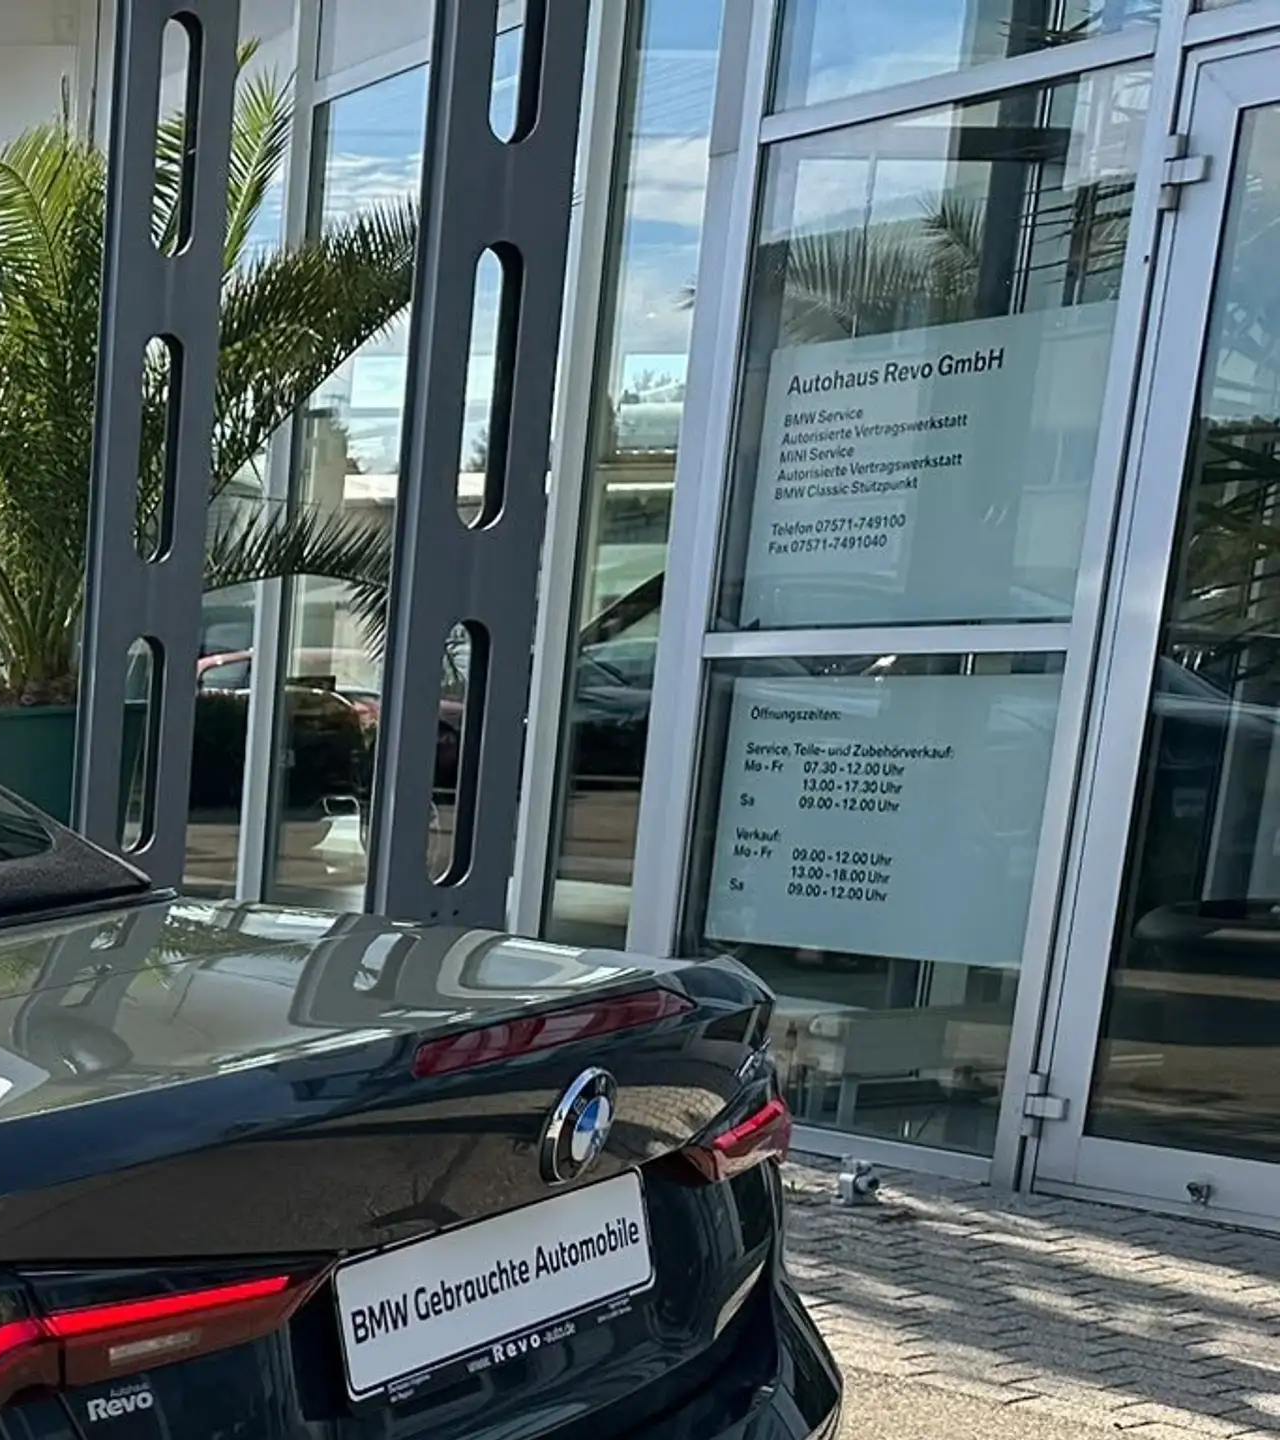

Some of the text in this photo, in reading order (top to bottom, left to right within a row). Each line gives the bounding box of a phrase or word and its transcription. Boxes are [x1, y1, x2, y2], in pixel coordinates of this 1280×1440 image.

[787, 348, 1005, 396] Autohaus Revo GmbH
[784, 408, 864, 428] BMW Service
[781, 414, 968, 446] Autorisierte Vertragswerkstatt
[779, 446, 855, 464] MINI Service
[777, 453, 963, 483] Autorisierte Vertragswerkstatt
[775, 484, 805, 500] BMW
[807, 481, 850, 497] Classic
[771, 513, 906, 537] Telefon 07571-749100
[768, 534, 888, 555] Fax 07571-7491040
[828, 745, 850, 757] und
[744, 760, 762, 772] Mo
[771, 760, 784, 772] Fr
[803, 761, 837, 775] 07.30
[847, 762, 880, 776] 12.00
[882, 763, 905, 777] Uhr
[803, 779, 835, 792] 13.00
[844, 780, 877, 794] 17.30
[880, 781, 902, 795] Uhr
[740, 794, 755, 807] Sa
[799, 796, 833, 810] 09.00
[842, 798, 875, 812] 12.00
[877, 799, 900, 813] Uhr
[736, 827, 782, 842] Verkauf:
[733, 844, 752, 858] Mo
[761, 846, 773, 858] Fr
[793, 848, 826, 862] 09.00
[835, 850, 868, 864] 12.00
[870, 852, 892, 865] Uhr
[791, 866, 824, 879] 13.00
[868, 870, 891, 884] Uhr
[729, 878, 744, 891] Sa
[787, 883, 821, 897] 09.00
[831, 886, 863, 900] 12.00
[865, 887, 888, 902] Uhr
[351, 1294, 408, 1344] BMW
[414, 1259, 530, 1321] Gebrauchte
[535, 1217, 640, 1279] Automobile
[492, 1332, 541, 1364] Revo
[86, 1391, 154, 1422] Revo
